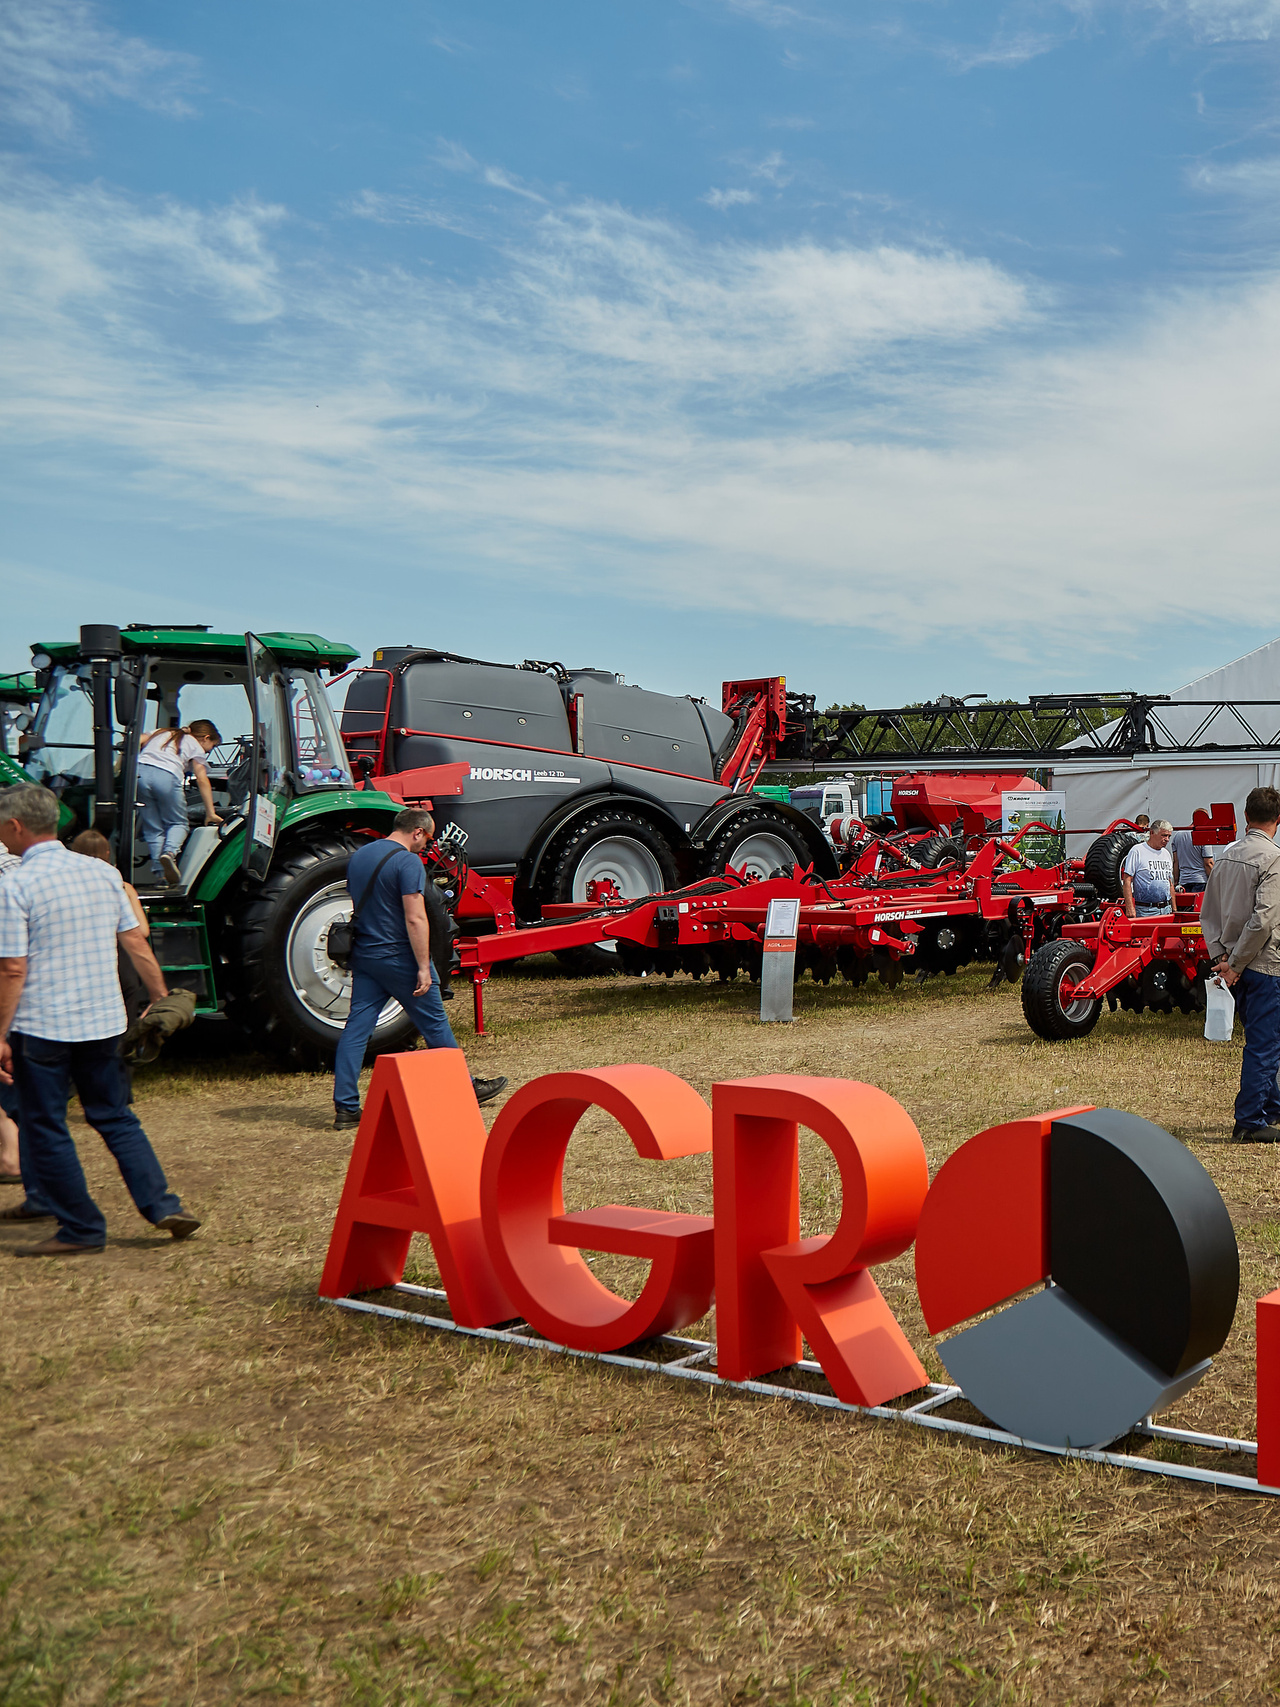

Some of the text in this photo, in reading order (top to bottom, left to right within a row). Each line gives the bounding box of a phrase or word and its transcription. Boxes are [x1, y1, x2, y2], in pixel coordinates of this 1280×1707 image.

[470, 767, 531, 781] HORSCH
[874, 911, 905, 922] HORSCH
[318, 1047, 1240, 1449] AGRO
